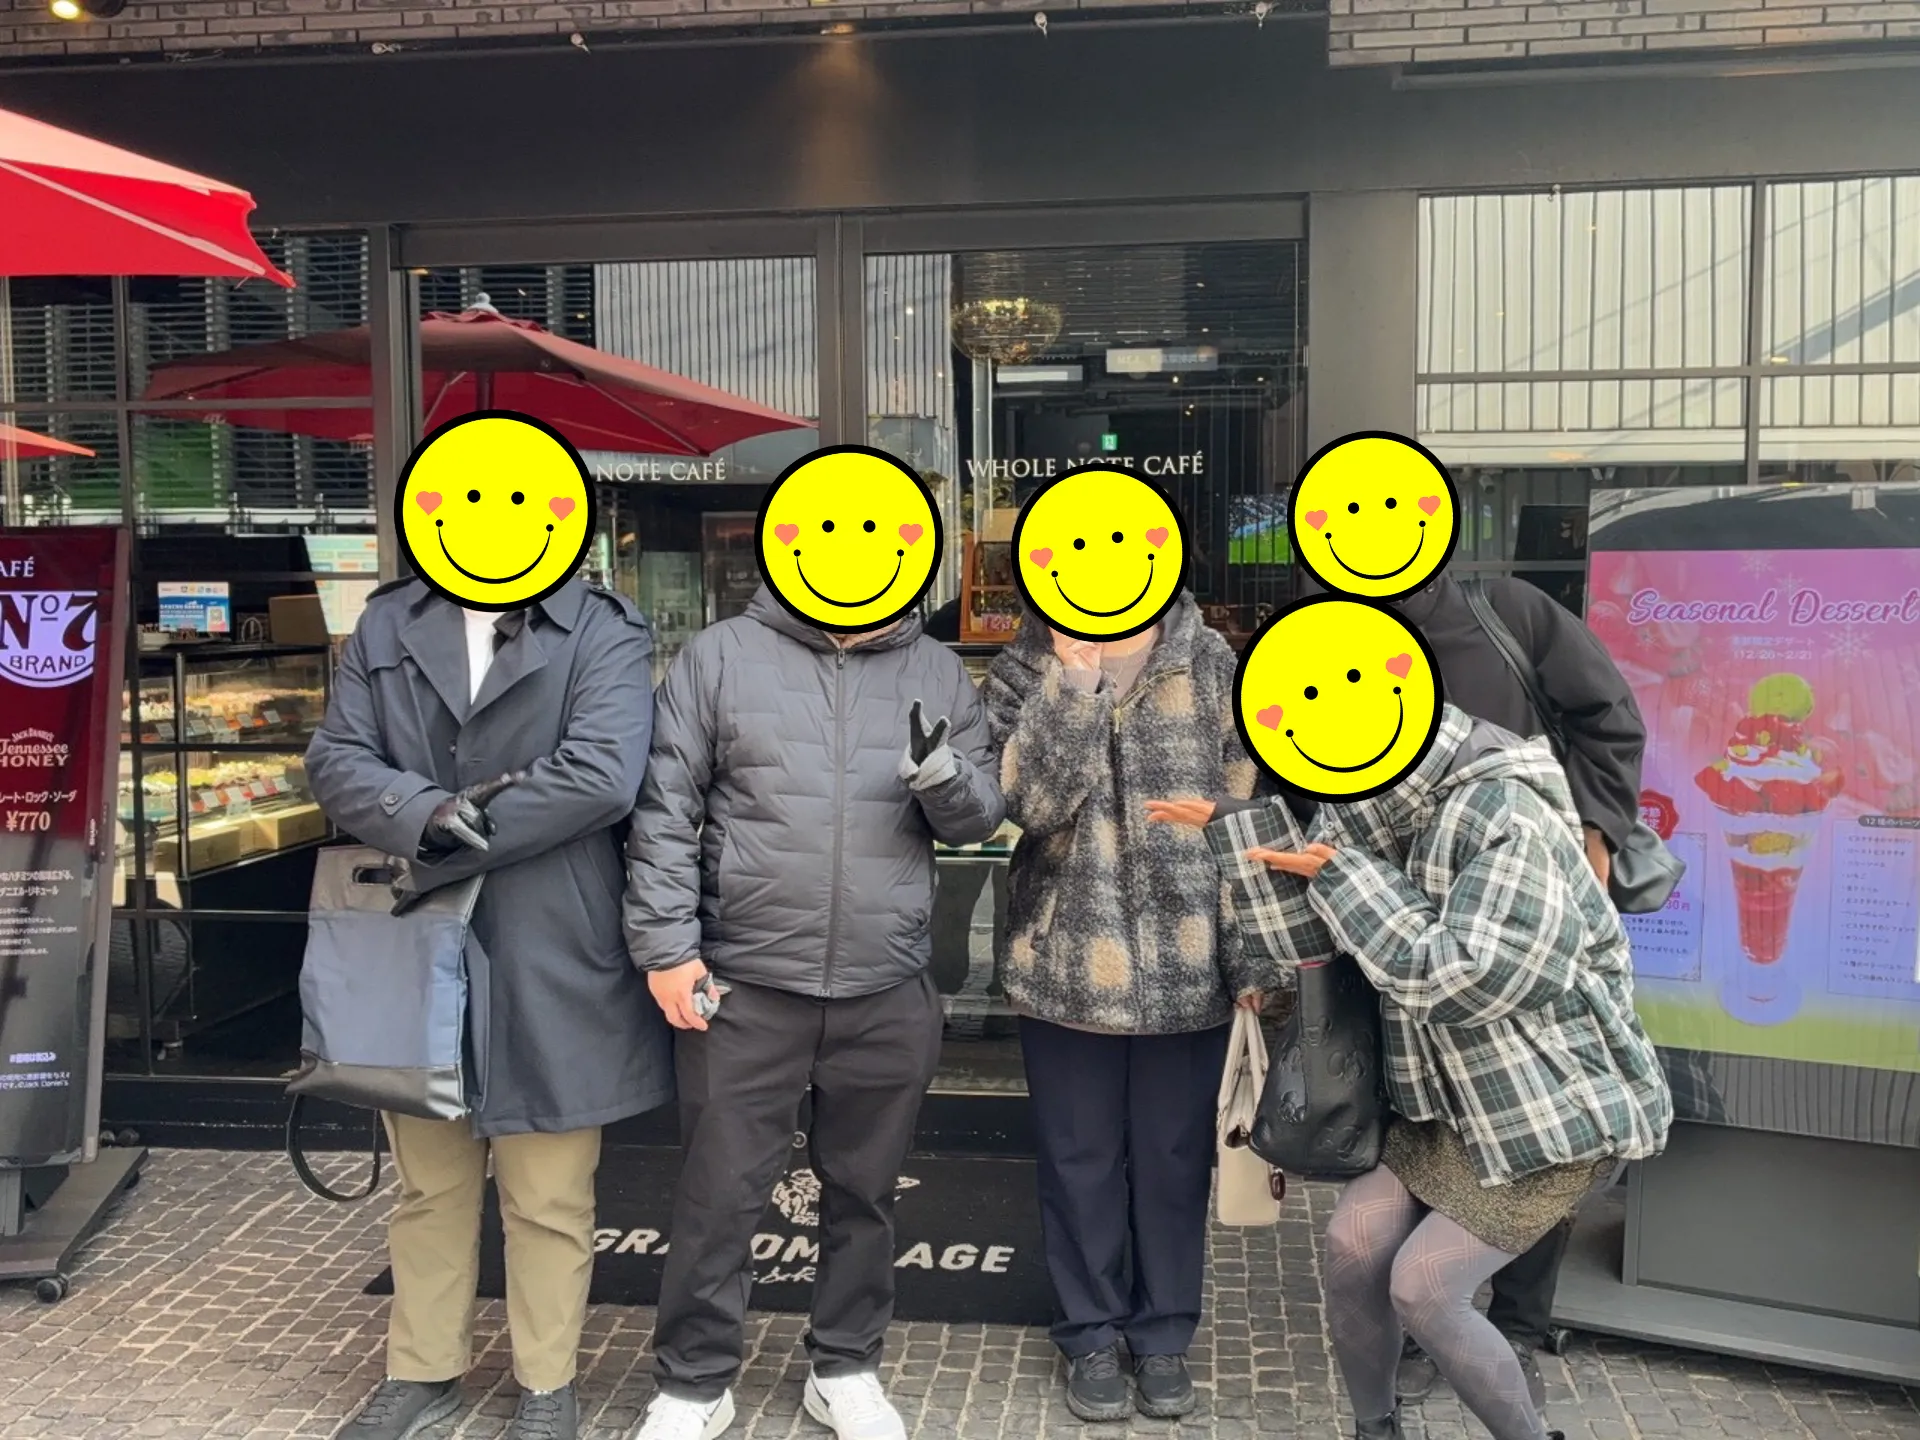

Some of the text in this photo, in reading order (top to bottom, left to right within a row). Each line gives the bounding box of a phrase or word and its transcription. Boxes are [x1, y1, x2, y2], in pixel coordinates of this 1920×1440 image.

[596, 457, 726, 482] NOTE CAFÉ
[966, 458, 1056, 478] WHOLE
[1144, 450, 1204, 475] CAFÉ
[1628, 587, 1778, 624] Seasonal
[10, 655, 86, 674] BRAND
[6, 810, 52, 832] ¥770
